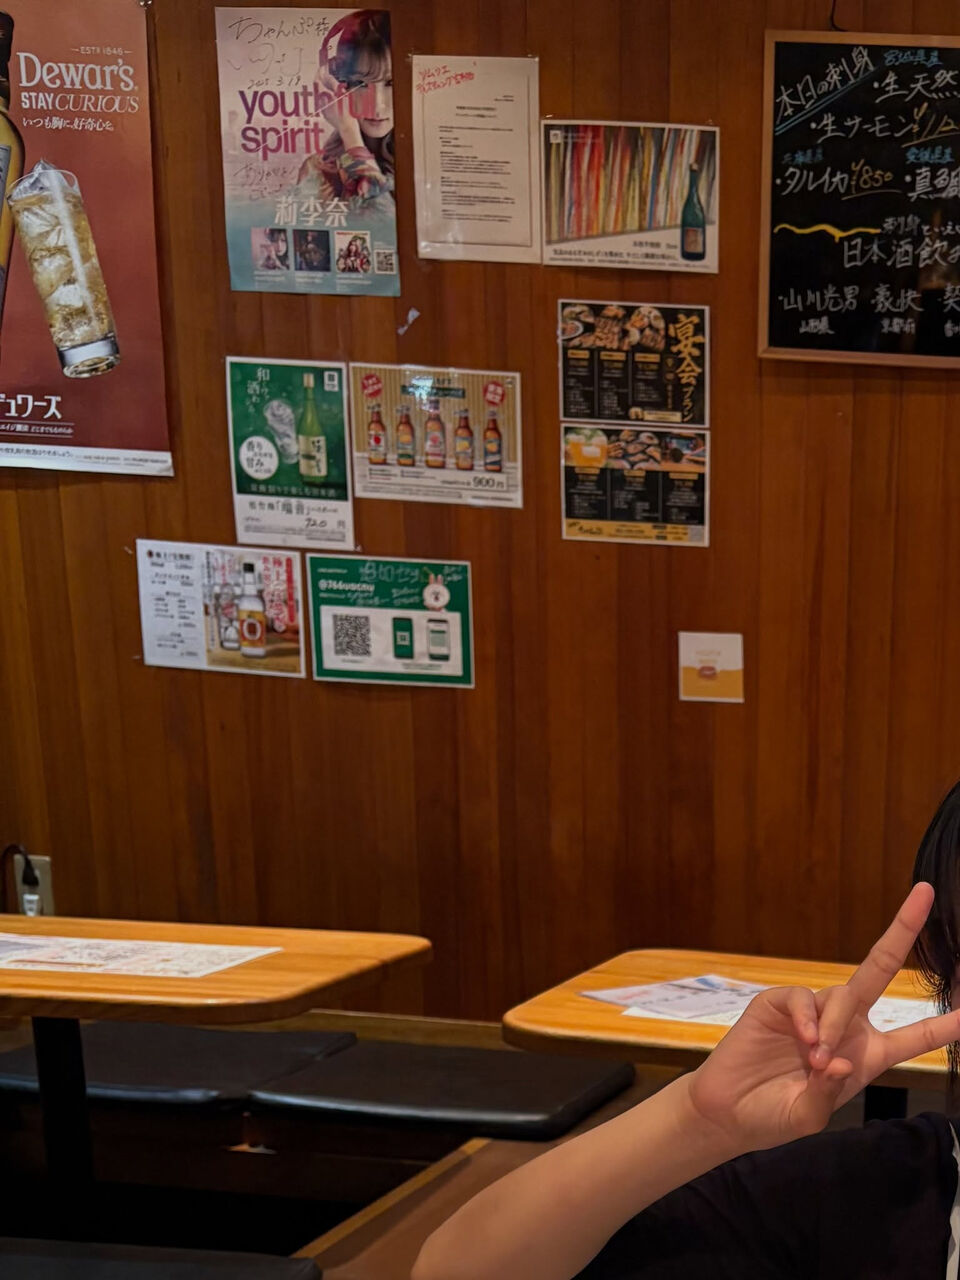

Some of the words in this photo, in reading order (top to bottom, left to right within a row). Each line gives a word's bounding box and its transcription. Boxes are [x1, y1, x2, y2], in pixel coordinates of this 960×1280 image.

[16, 52, 134, 91] Dewar's
[775, 46, 875, 125] 本日の刺身
[21, 92, 56, 110] STAY
[55, 93, 139, 113] CURIOUS
[238, 82, 376, 124] youthful
[241, 119, 325, 161] spirit
